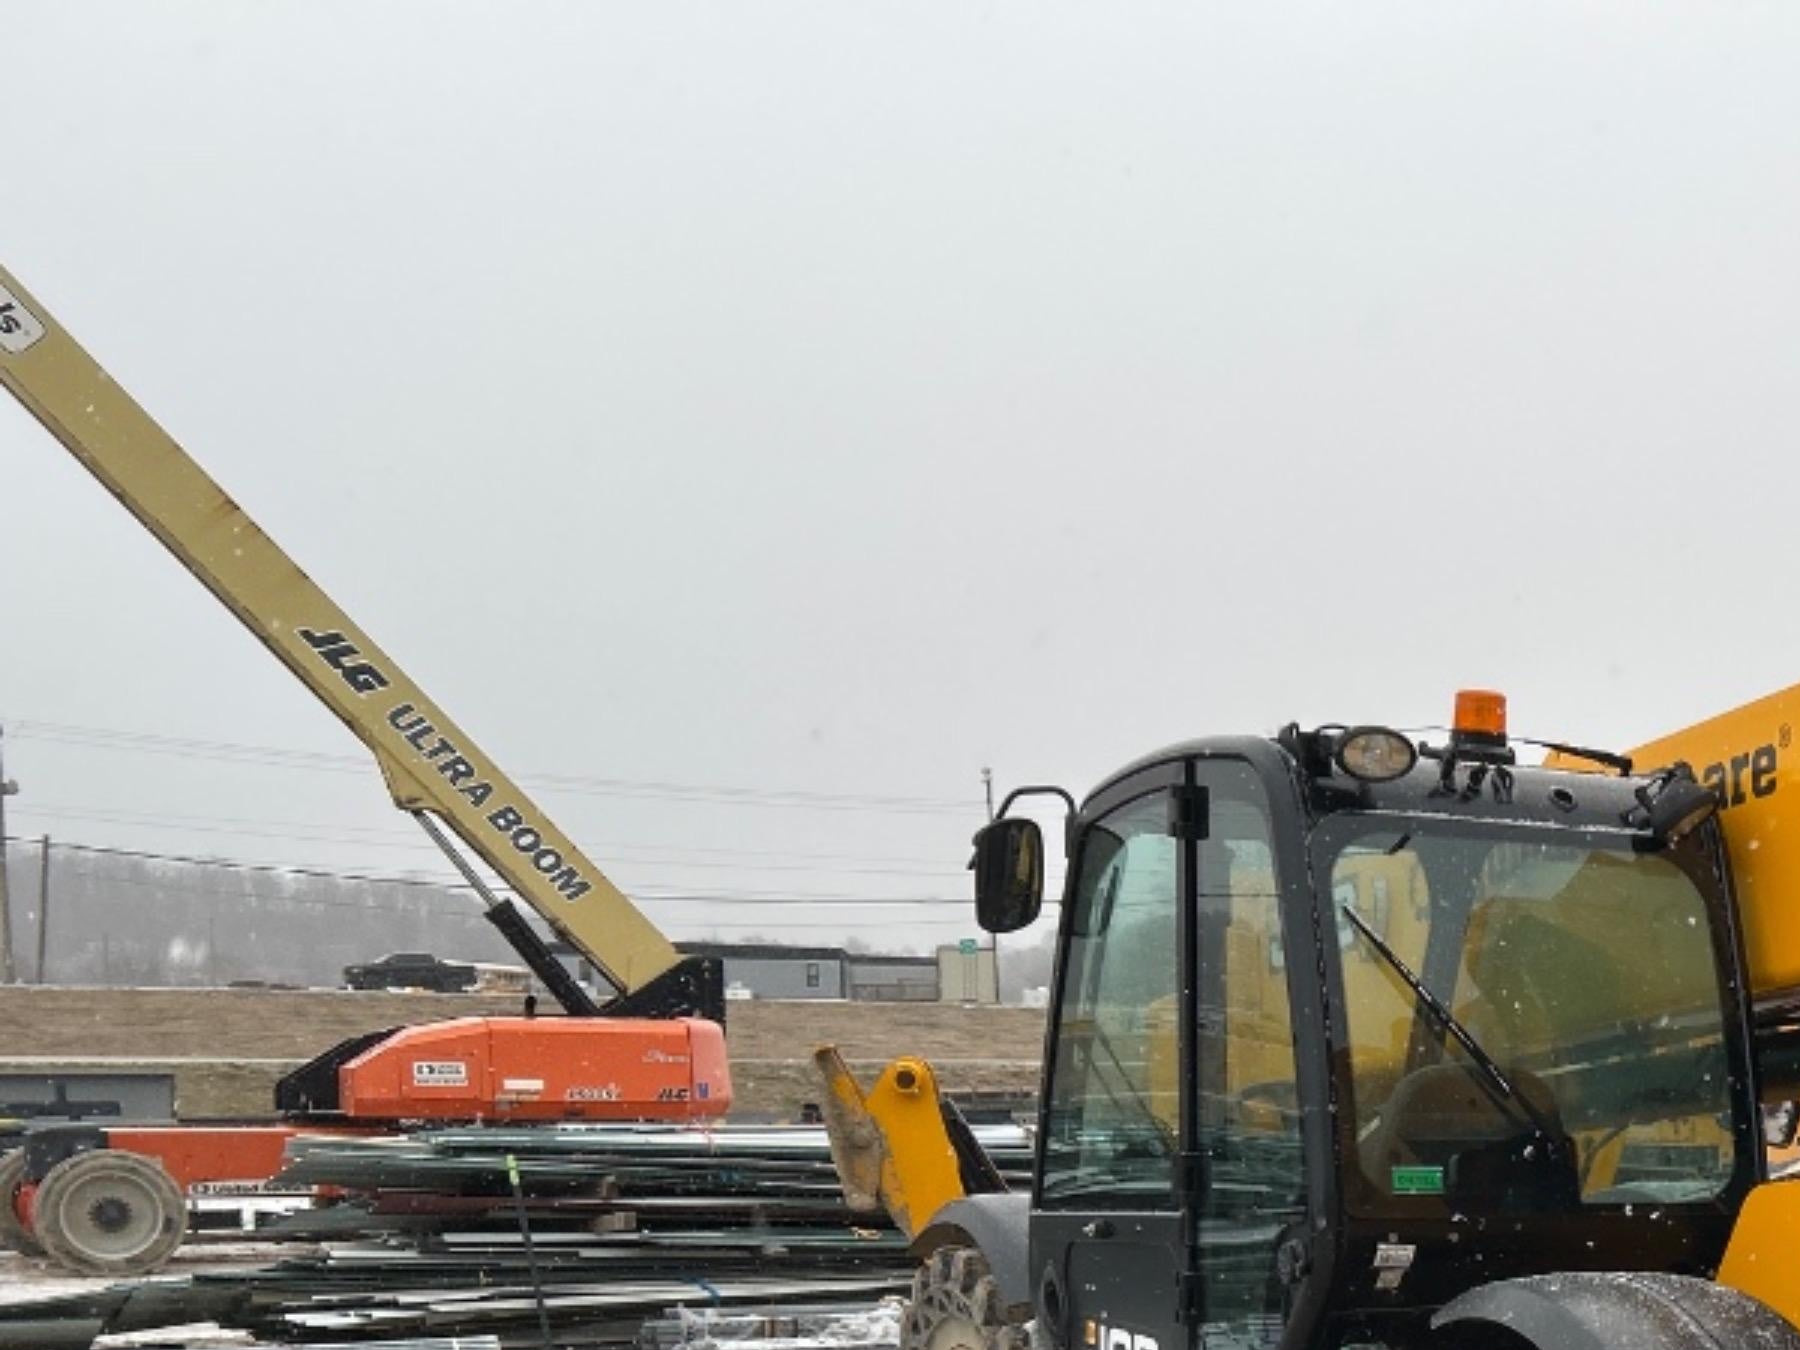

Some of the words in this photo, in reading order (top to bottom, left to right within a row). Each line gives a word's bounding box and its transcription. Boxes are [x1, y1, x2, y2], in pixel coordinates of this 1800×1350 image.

[295, 626, 391, 698] JLG
[386, 702, 494, 808] ULTRA
[486, 804, 592, 901] BOOM
